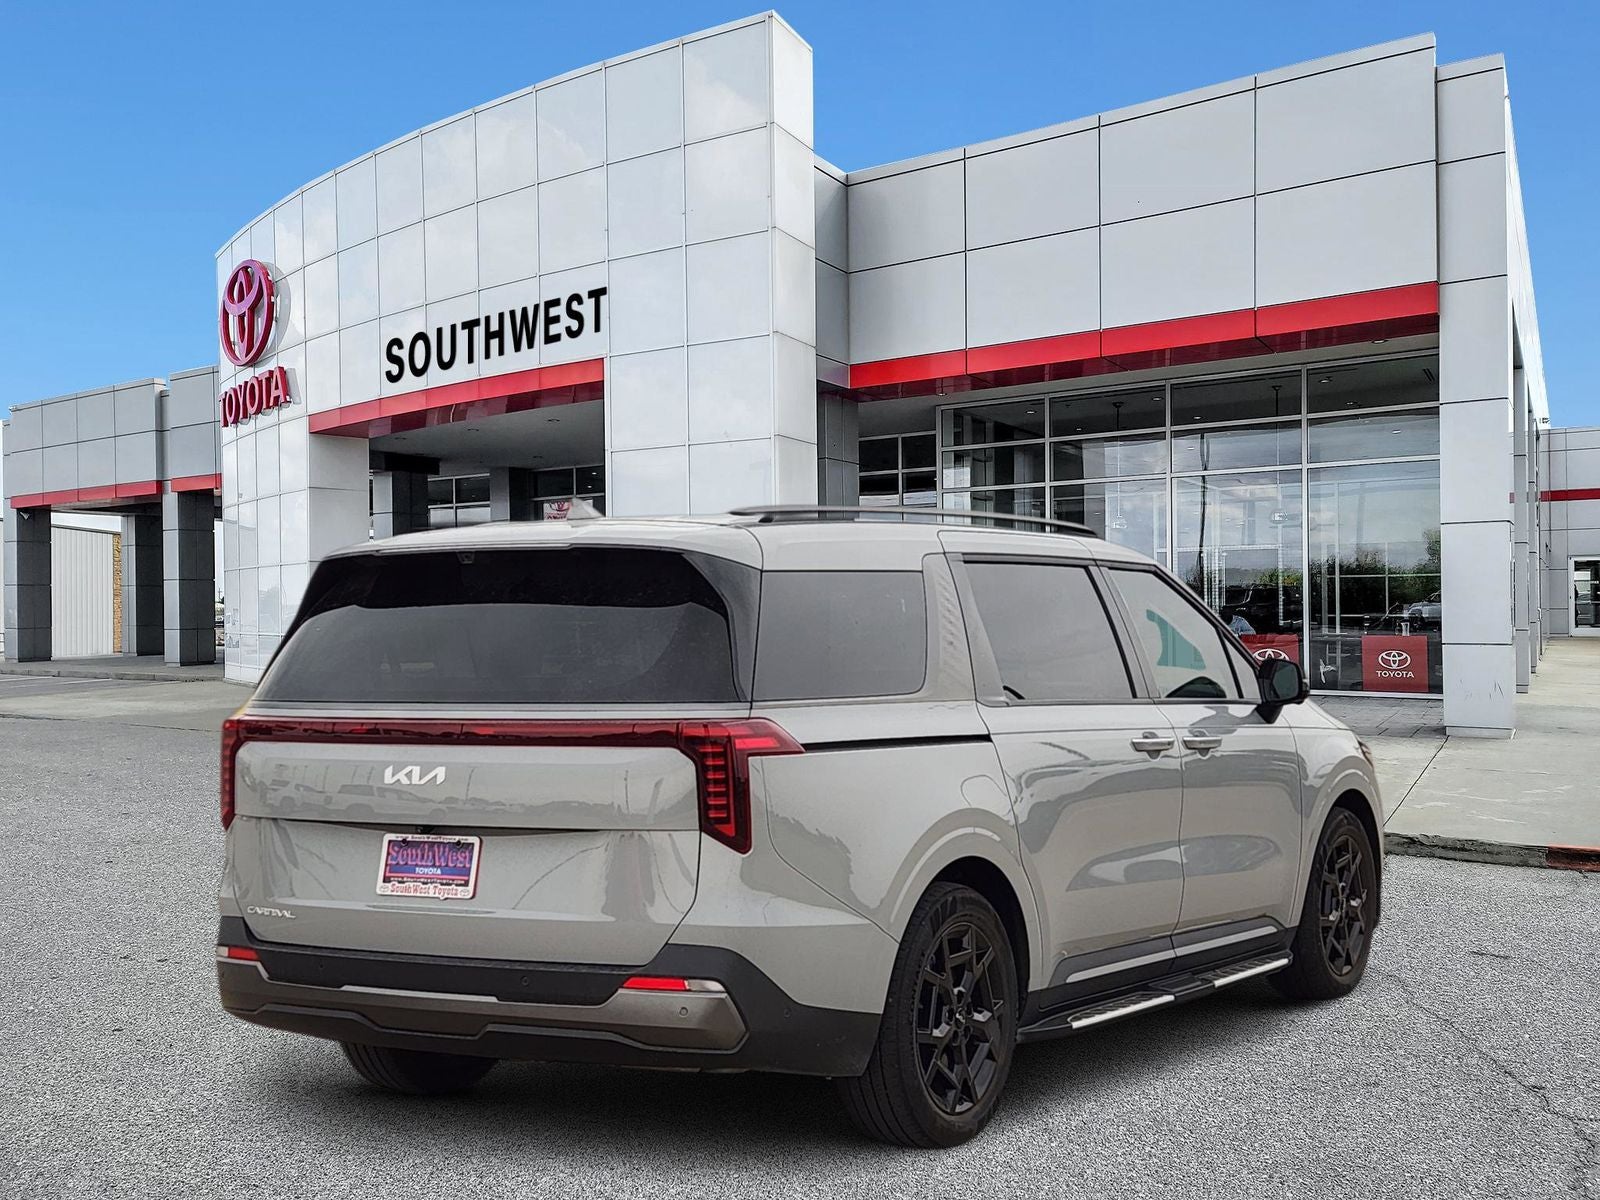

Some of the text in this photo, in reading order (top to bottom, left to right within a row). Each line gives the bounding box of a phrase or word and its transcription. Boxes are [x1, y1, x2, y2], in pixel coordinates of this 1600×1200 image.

[385, 286, 608, 384] SOUTHWEST
[219, 367, 287, 428] TOYOTA
[384, 765, 446, 785] KIA
[415, 867, 442, 875] TOYOTA
[433, 885, 459, 898] Toyota
